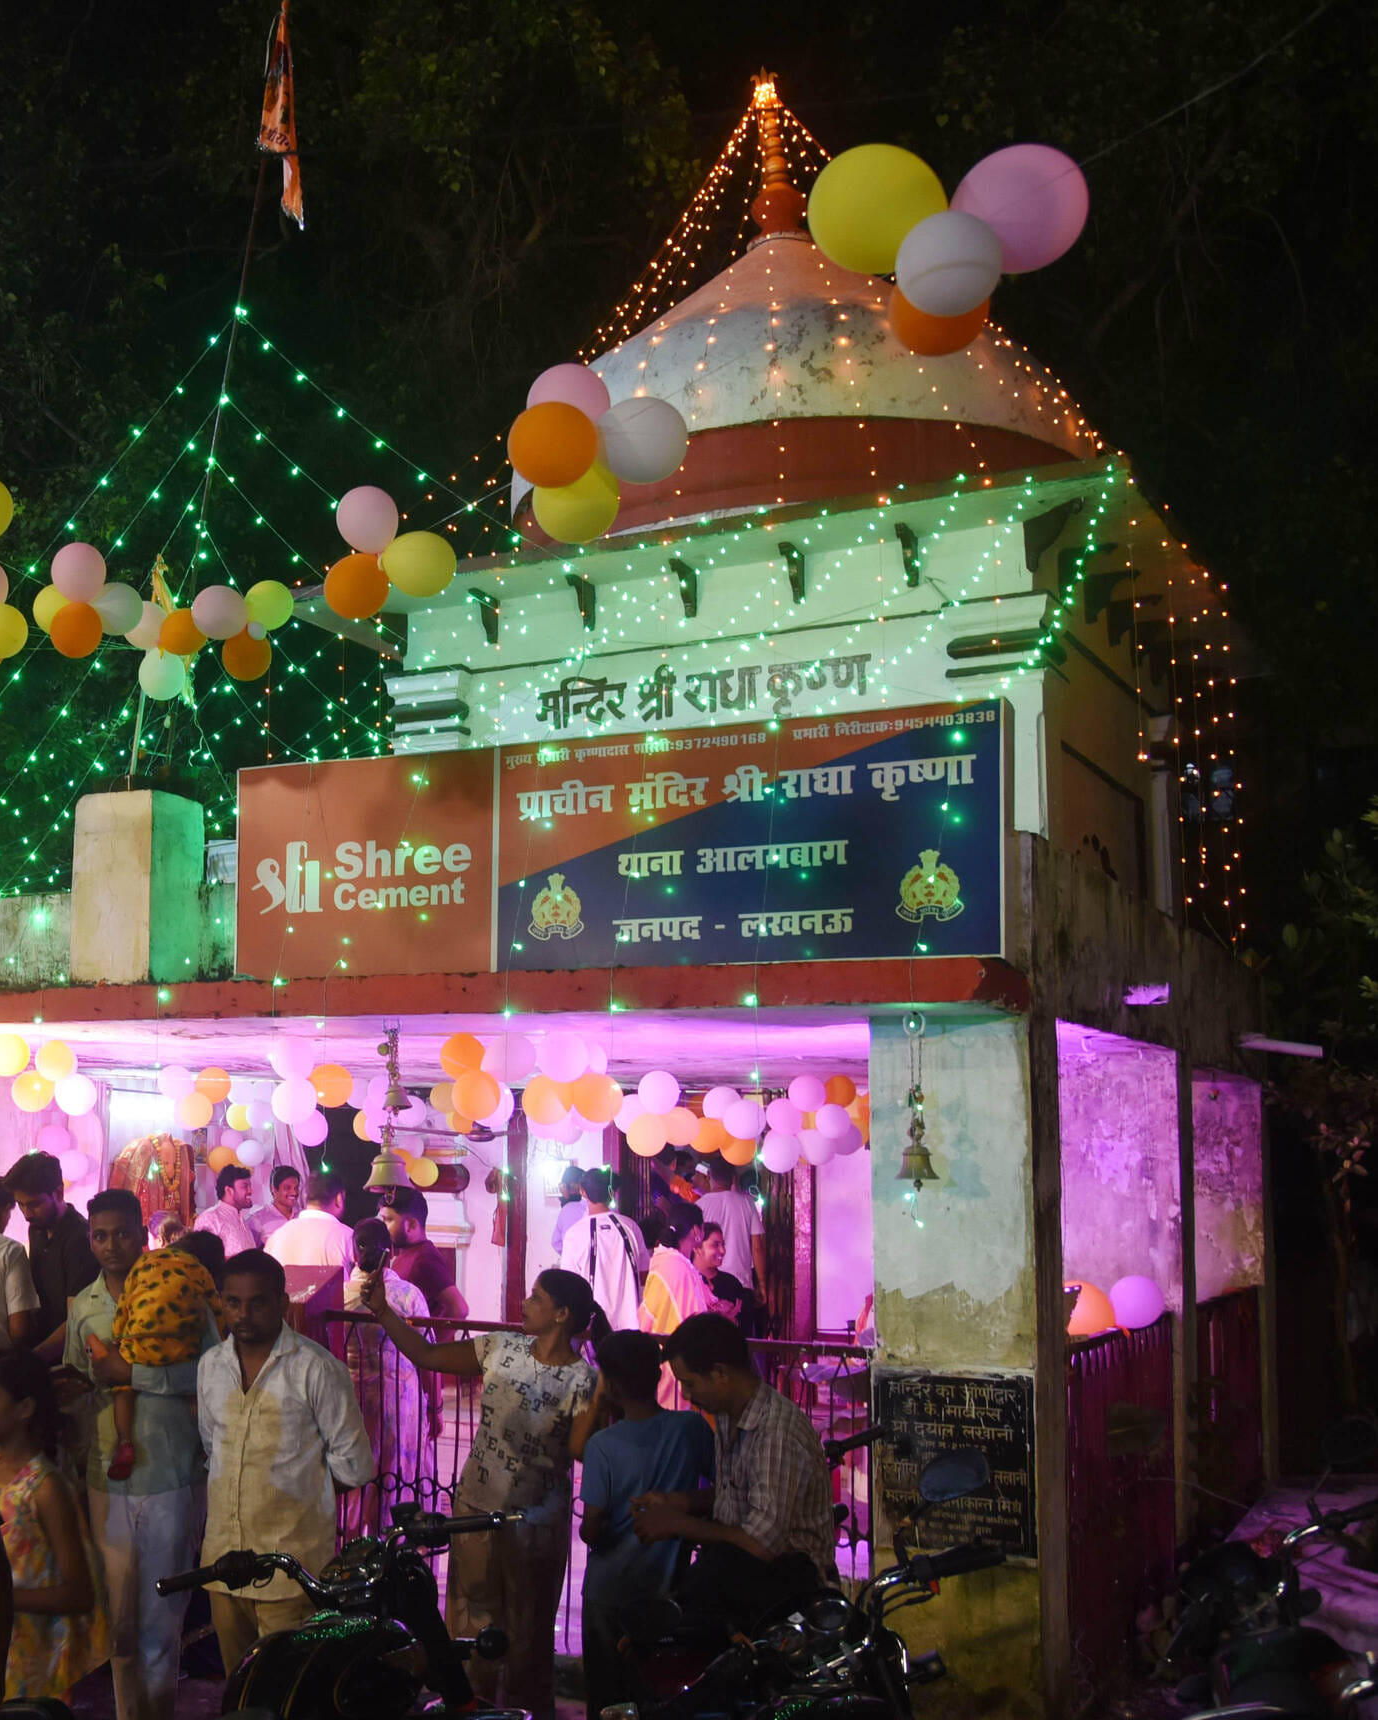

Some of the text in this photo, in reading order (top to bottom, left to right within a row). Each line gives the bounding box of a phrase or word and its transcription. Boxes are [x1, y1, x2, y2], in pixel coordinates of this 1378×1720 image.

[536, 653, 872, 730] मन्दिर श्री राधा कृष्ण
[516, 754, 977, 821] प्राचीन मंदिर श्री राधा कृष्णा
[334, 839, 472, 880] Shree
[617, 840, 849, 878] थाना आलमबाग
[333, 876, 465, 911] Cement
[612, 916, 703, 943] जनपद
[738, 908, 854, 939] लखनऊ
[935, 1384, 956, 1398] का
